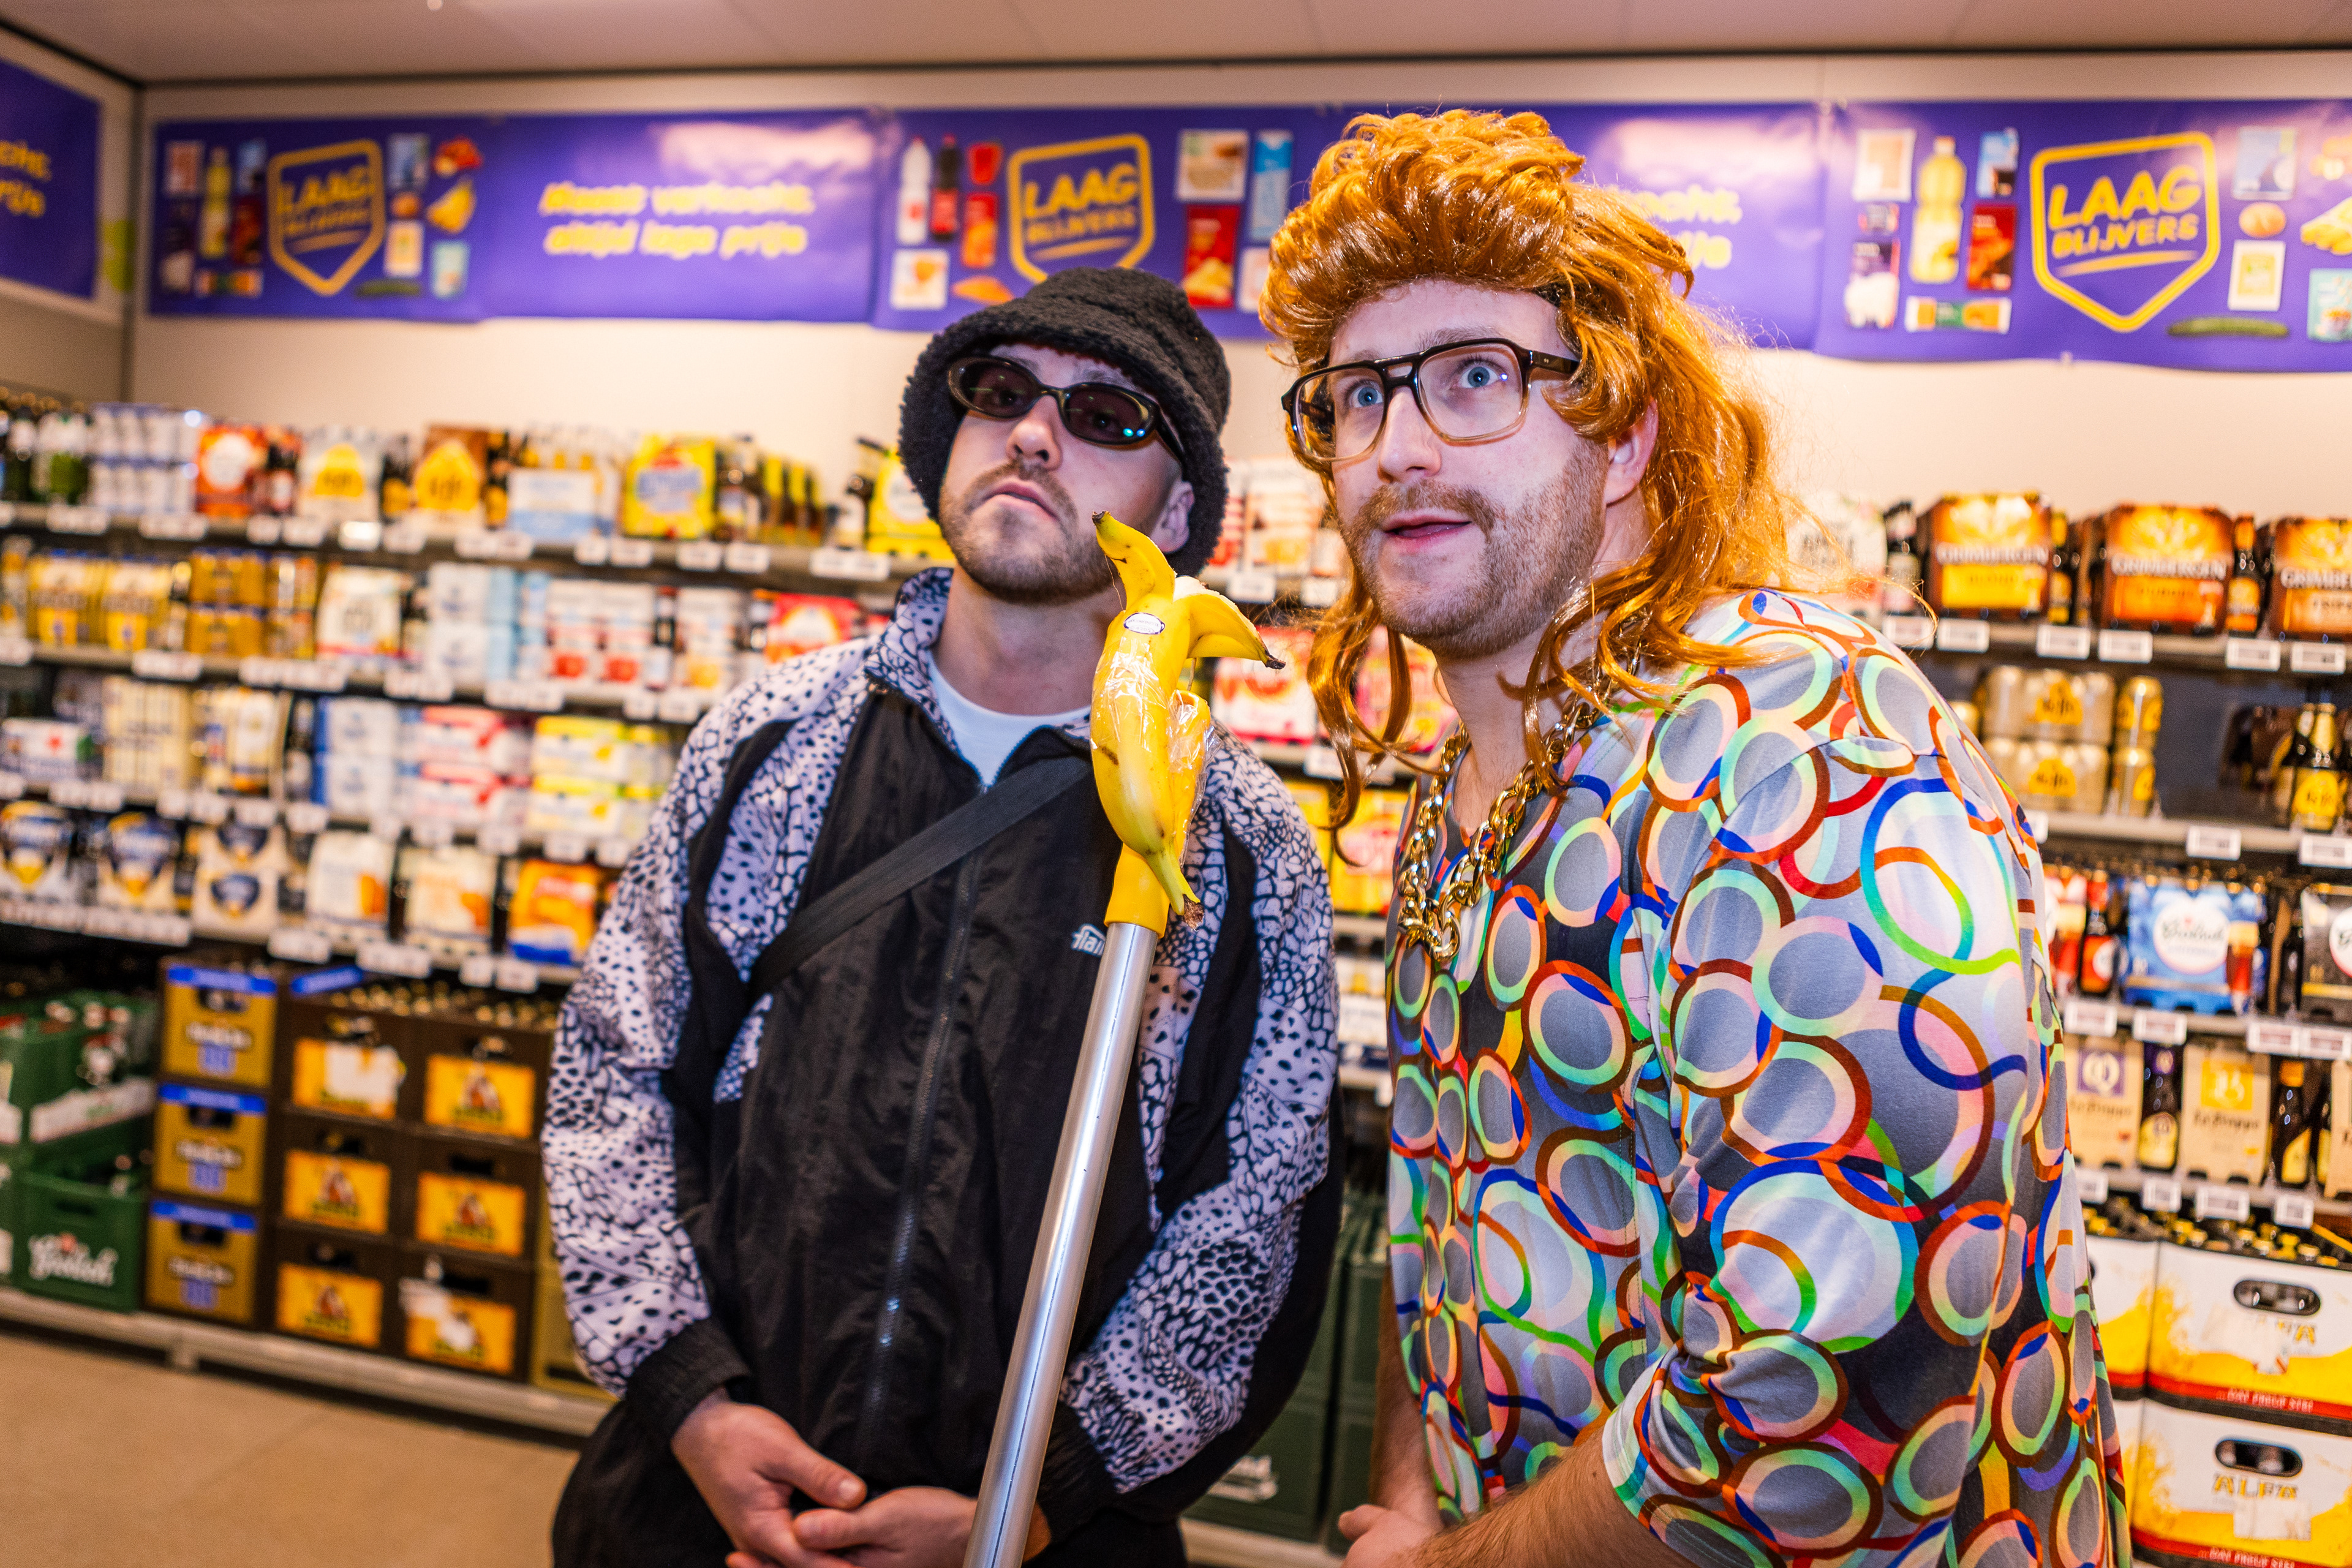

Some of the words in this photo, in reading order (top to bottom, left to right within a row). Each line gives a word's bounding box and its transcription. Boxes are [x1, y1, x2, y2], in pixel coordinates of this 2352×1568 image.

[1023, 163, 1139, 217] LAAG
[2048, 164, 2203, 230] LAAG
[2052, 213, 2200, 258] BLIJVERS
